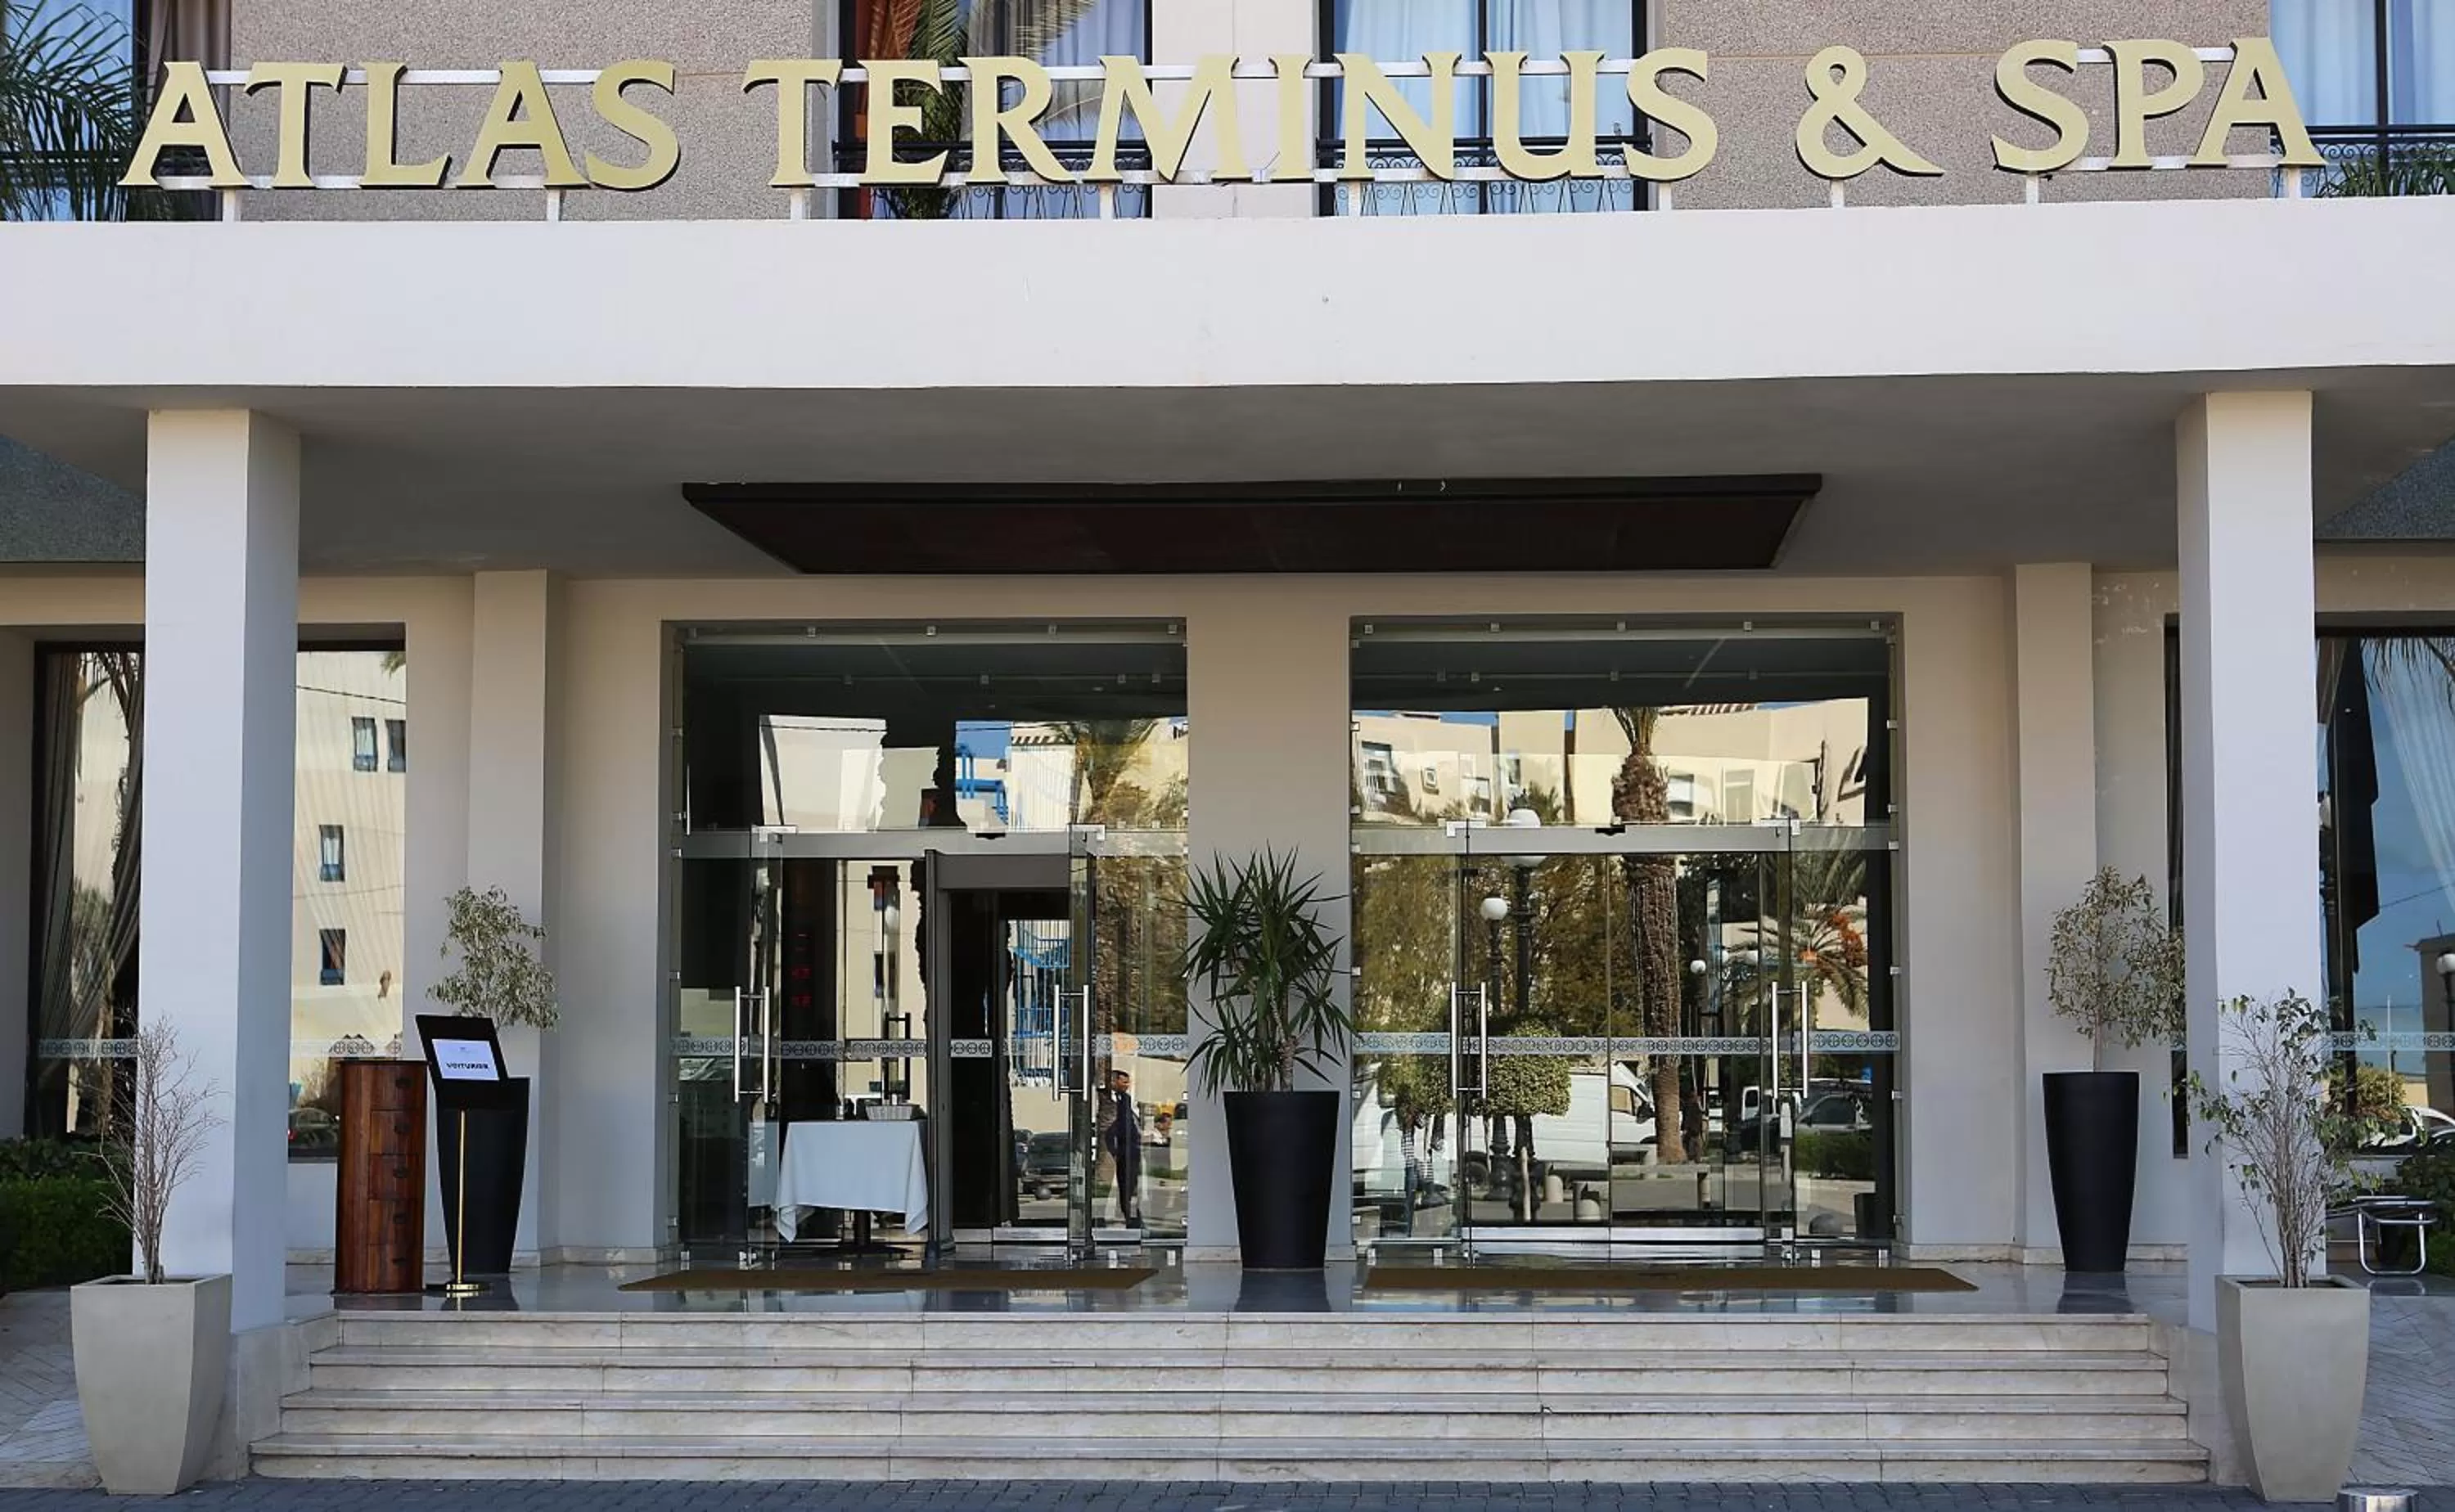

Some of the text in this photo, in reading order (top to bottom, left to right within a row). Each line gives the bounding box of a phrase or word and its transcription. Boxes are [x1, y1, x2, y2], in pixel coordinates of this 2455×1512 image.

[117, 36, 2328, 190] ATLAS TERMINUS & SPA
[446, 1062, 489, 1070] VOITURIER
